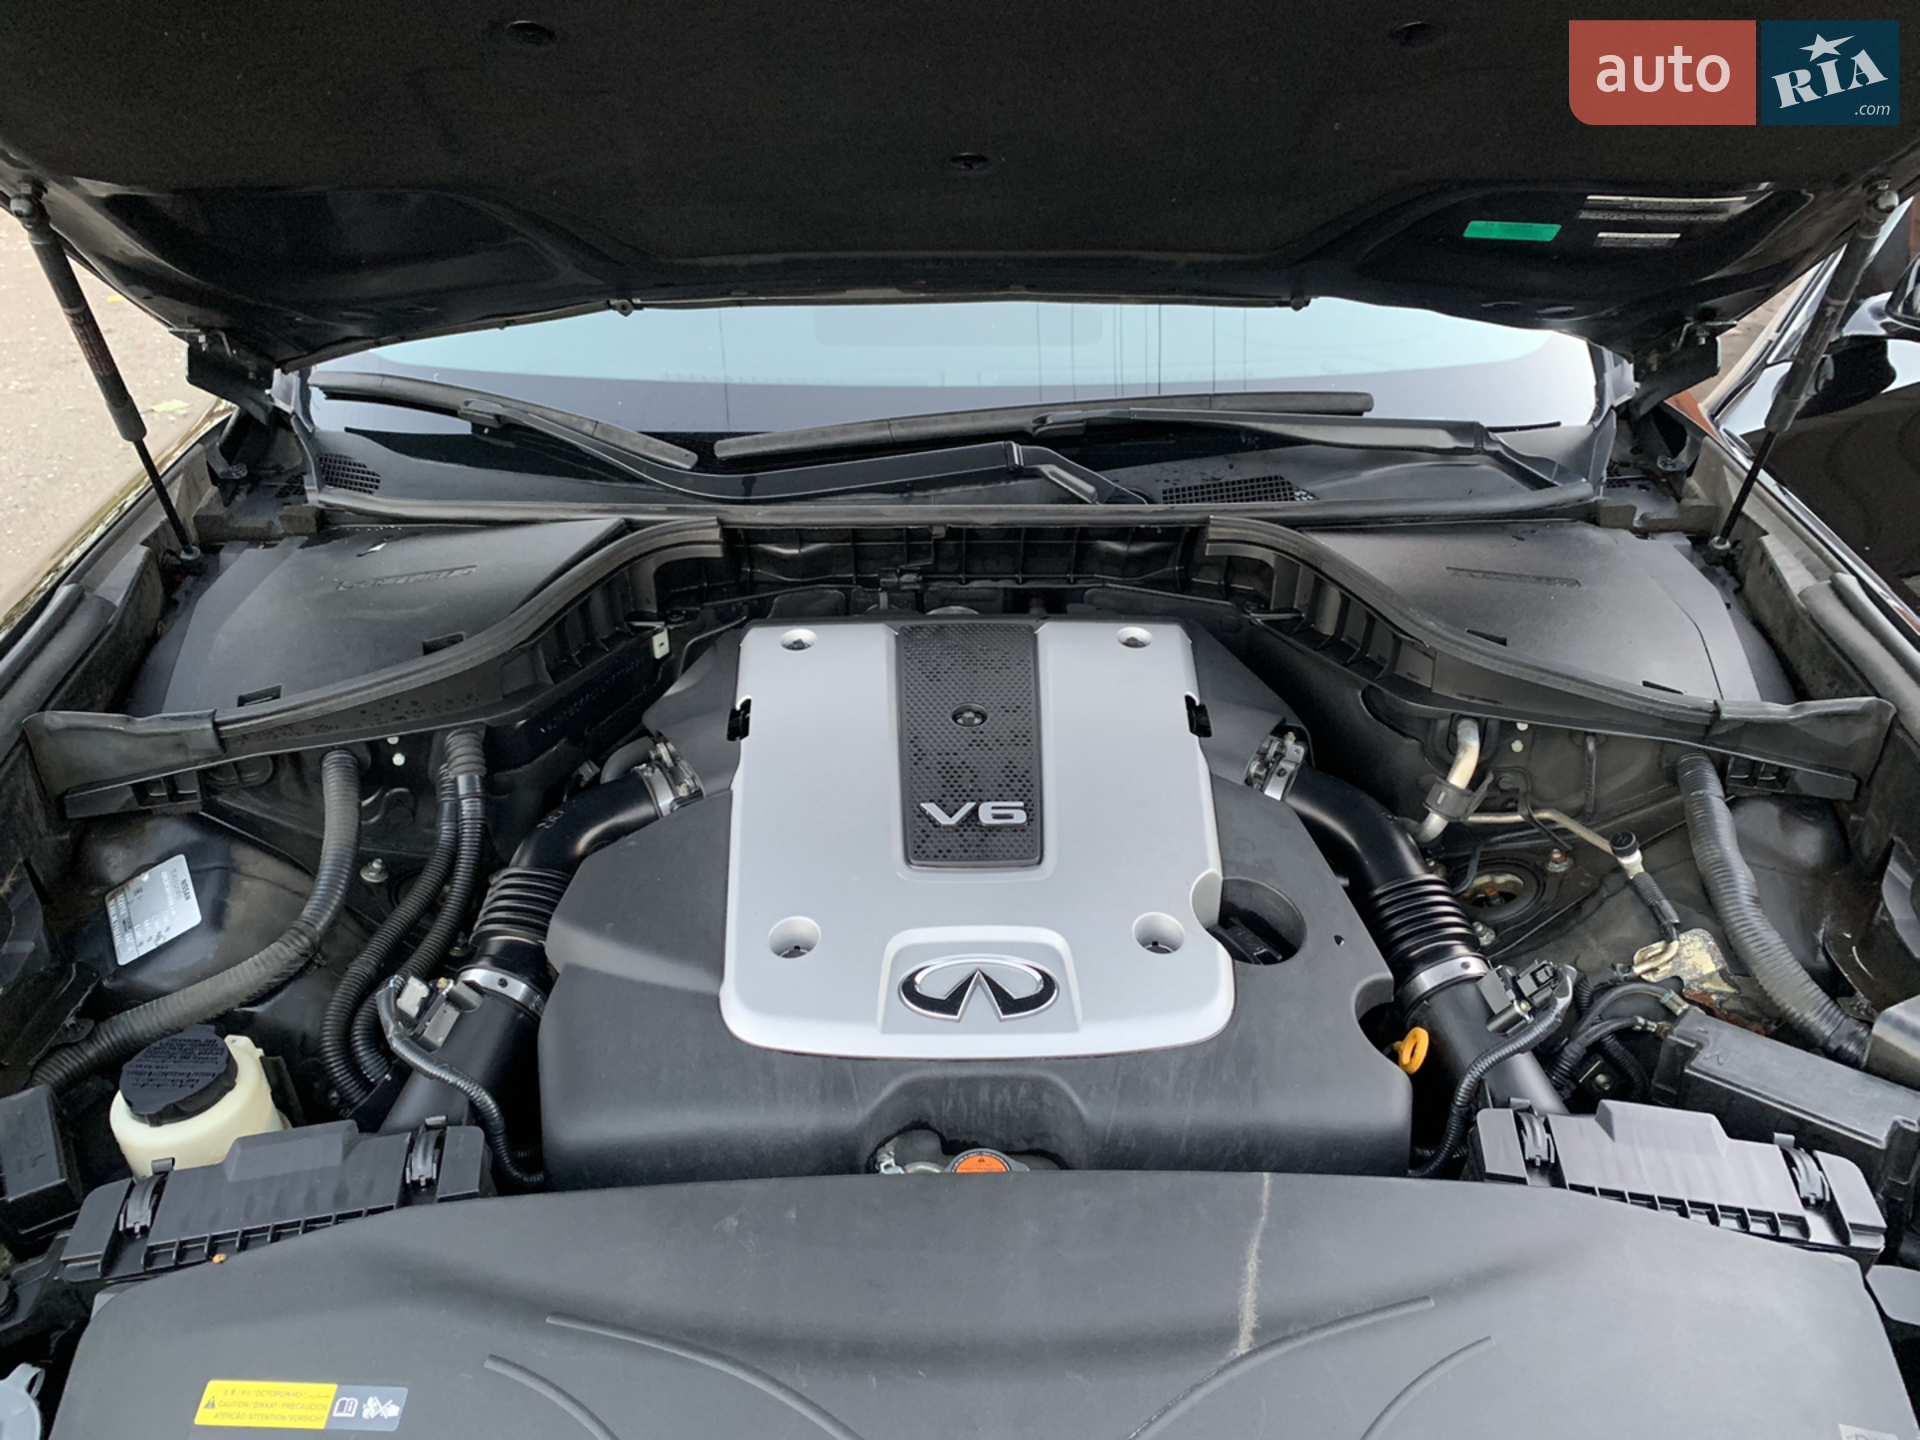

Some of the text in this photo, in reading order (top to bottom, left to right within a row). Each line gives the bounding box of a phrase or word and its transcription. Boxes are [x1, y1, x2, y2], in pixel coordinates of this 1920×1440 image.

[919, 801, 1028, 826] V6
[218, 1400, 249, 1409] CAUTION
[248, 1412, 287, 1421] ATTENTION
